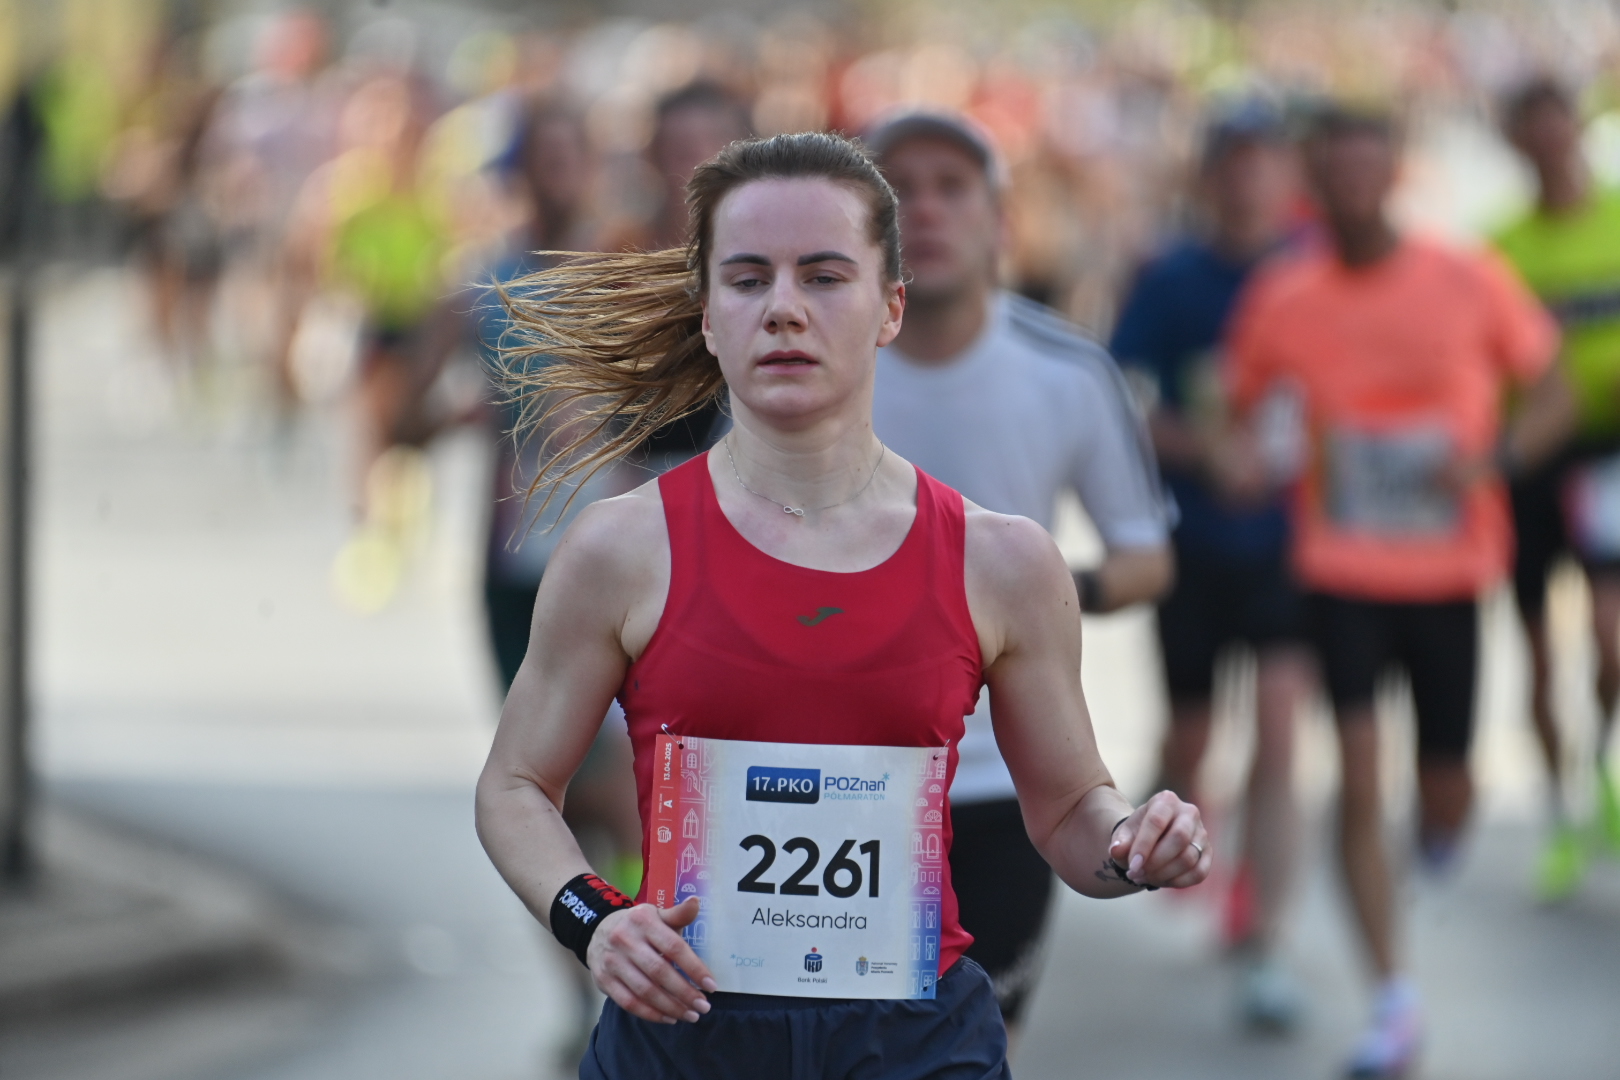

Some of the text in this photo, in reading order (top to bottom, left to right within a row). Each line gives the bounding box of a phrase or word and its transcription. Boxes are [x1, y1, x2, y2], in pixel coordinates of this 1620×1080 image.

[663, 742, 672, 781] 13.04.2025
[752, 776, 814, 794] 17.PKO
[663, 799, 673, 808] A
[737, 834, 881, 899] 2261
[656, 889, 666, 909] WER
[751, 907, 867, 930] Aleksandra
